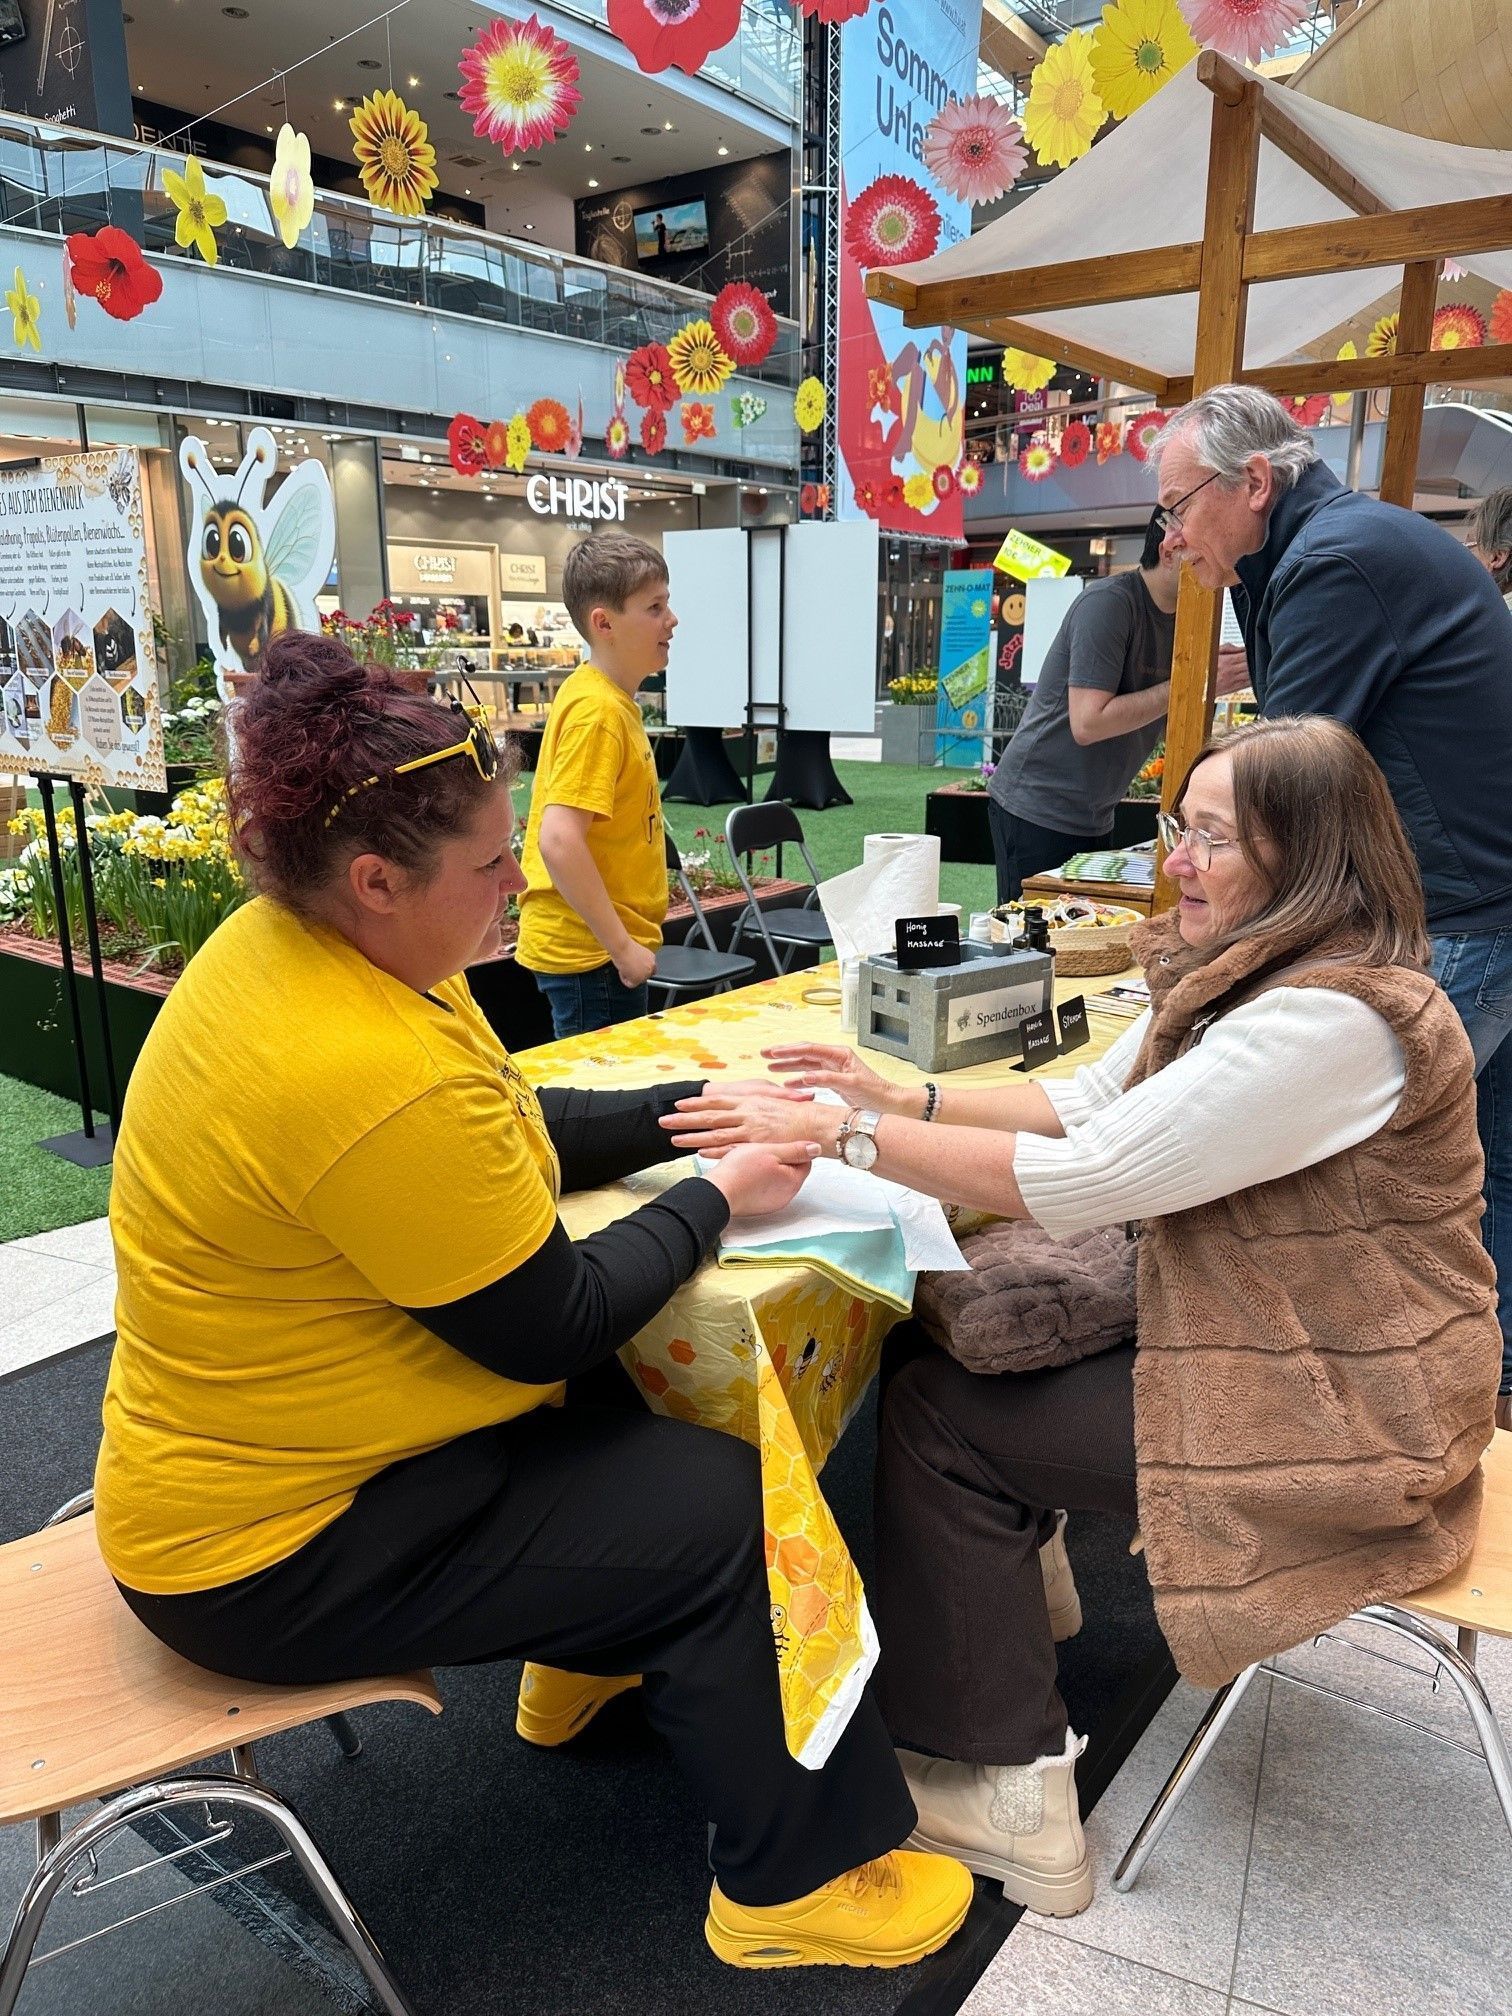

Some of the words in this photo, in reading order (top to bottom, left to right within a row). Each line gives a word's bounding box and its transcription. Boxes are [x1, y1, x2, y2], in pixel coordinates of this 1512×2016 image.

[877, 7, 965, 112] Somm
[877, 75, 930, 164] Urla
[1020, 400, 1043, 412] Deal
[8, 490, 22, 515] AUS
[22, 488, 39, 514] DEM
[39, 484, 85, 513] BIENENVOLK
[526, 474, 629, 521] CHRIST
[906, 921, 927, 936] Honig
[976, 1002, 1036, 1027] Spendenbox
